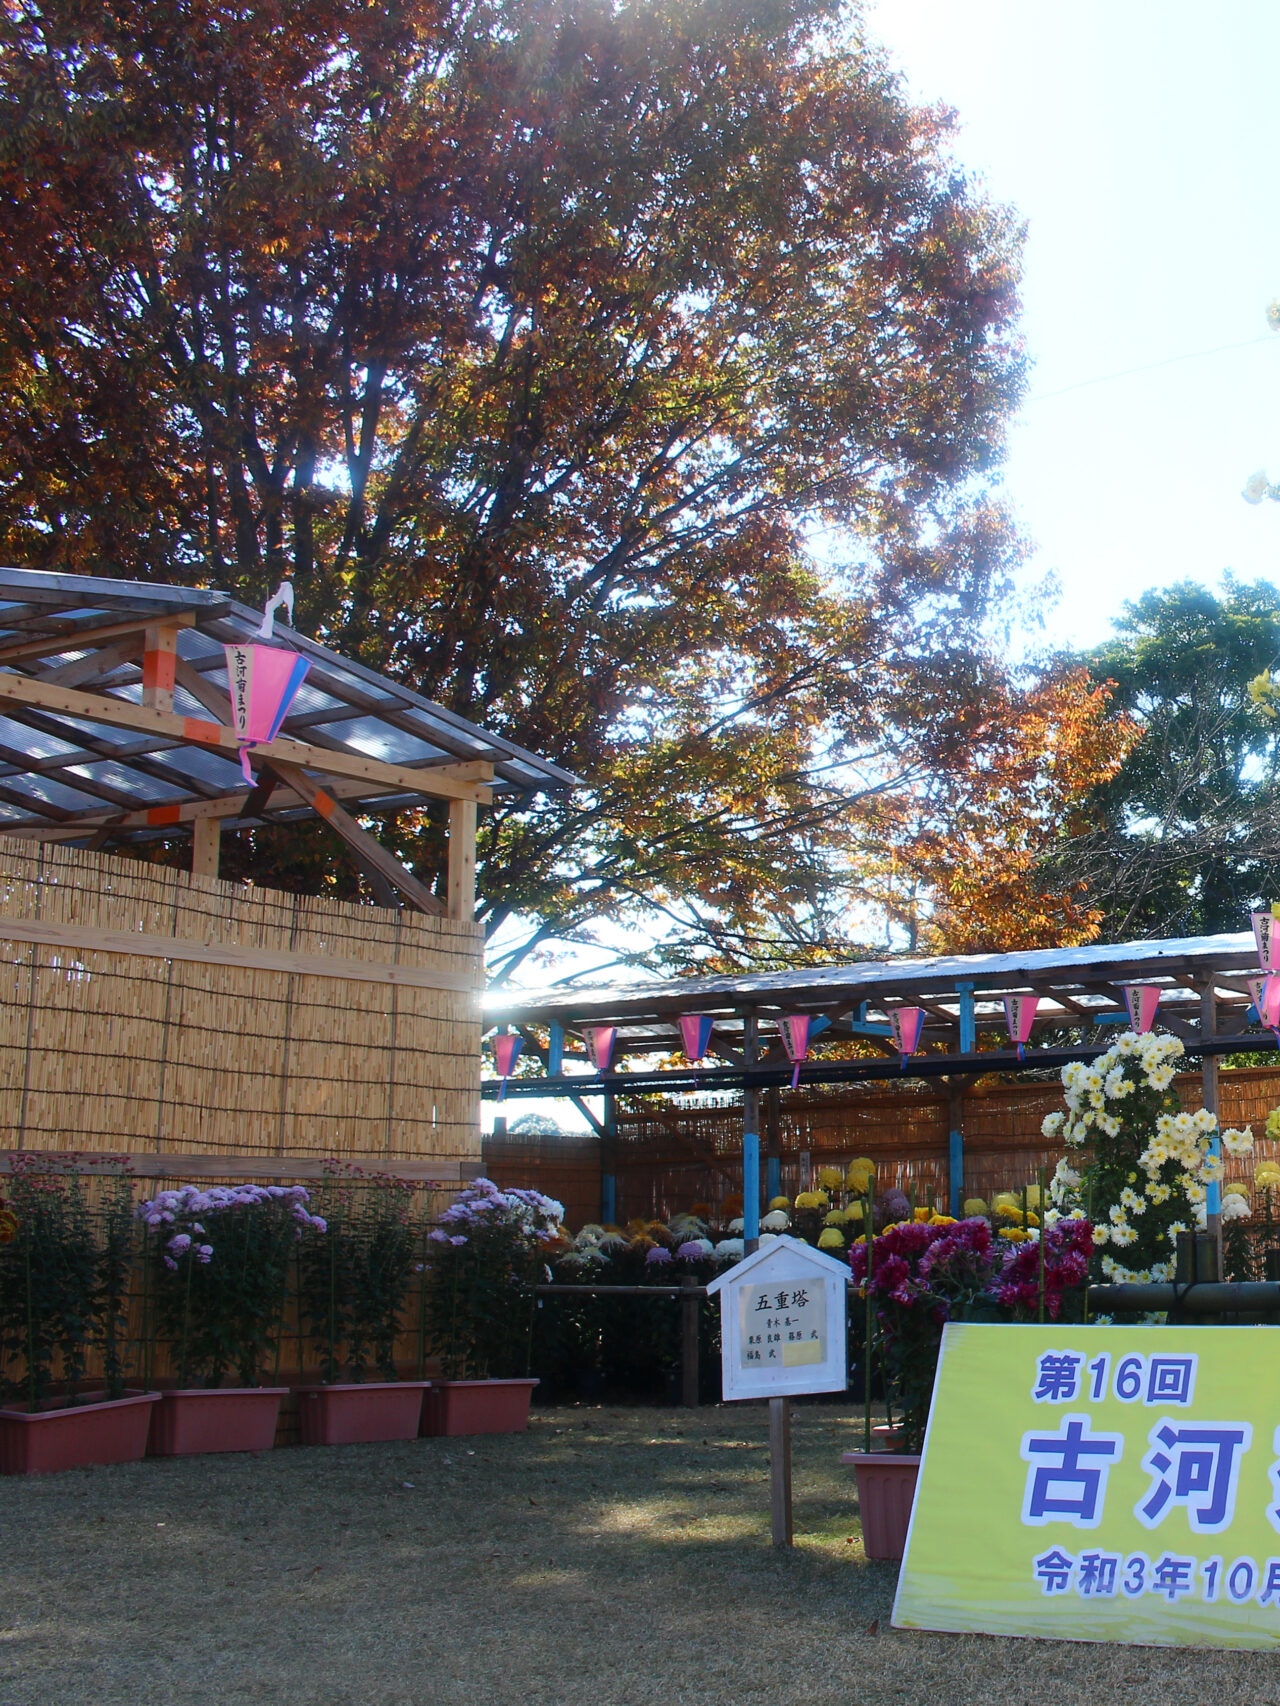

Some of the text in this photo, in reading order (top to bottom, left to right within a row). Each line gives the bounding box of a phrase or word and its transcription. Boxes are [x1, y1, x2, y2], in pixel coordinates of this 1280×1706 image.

[234, 651, 248, 729] 古河菊まつり
[1259, 917, 1271, 962] 古河菊まつり
[1131, 989, 1141, 1028] 古河菊まつり
[755, 1289, 810, 1311] 五重塔
[767, 1317, 781, 1329] 青木
[1035, 1354, 1193, 1403] 第16回
